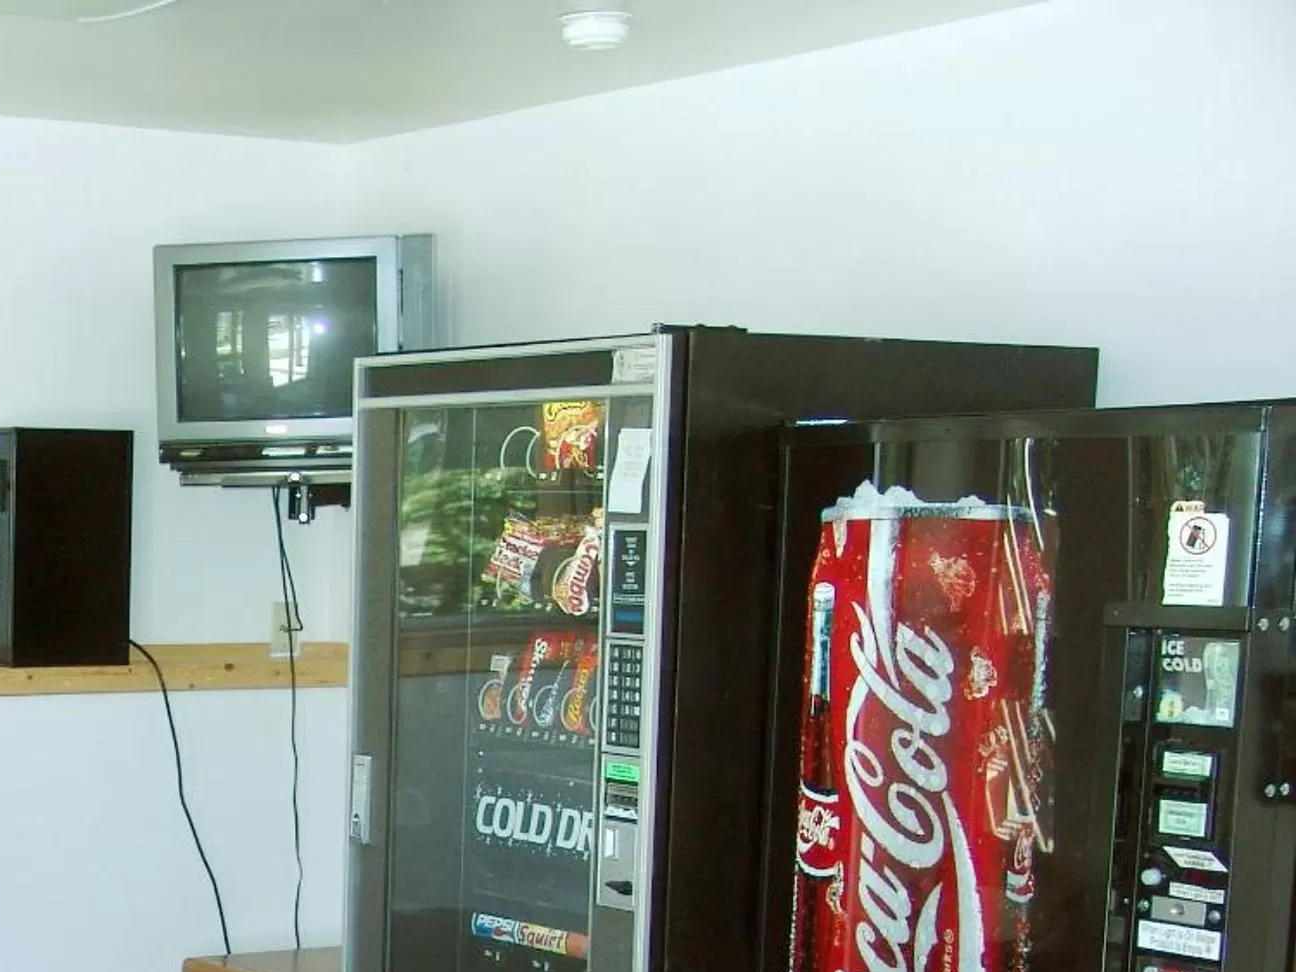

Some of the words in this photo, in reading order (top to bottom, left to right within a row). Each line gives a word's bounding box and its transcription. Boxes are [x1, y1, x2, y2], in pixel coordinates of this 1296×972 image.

[1161, 639, 1185, 655] ICE
[1162, 657, 1202, 673] COLD
[476, 795, 553, 844] COLD
[477, 913, 515, 932] PEPSI
[519, 925, 567, 951] Squirt
